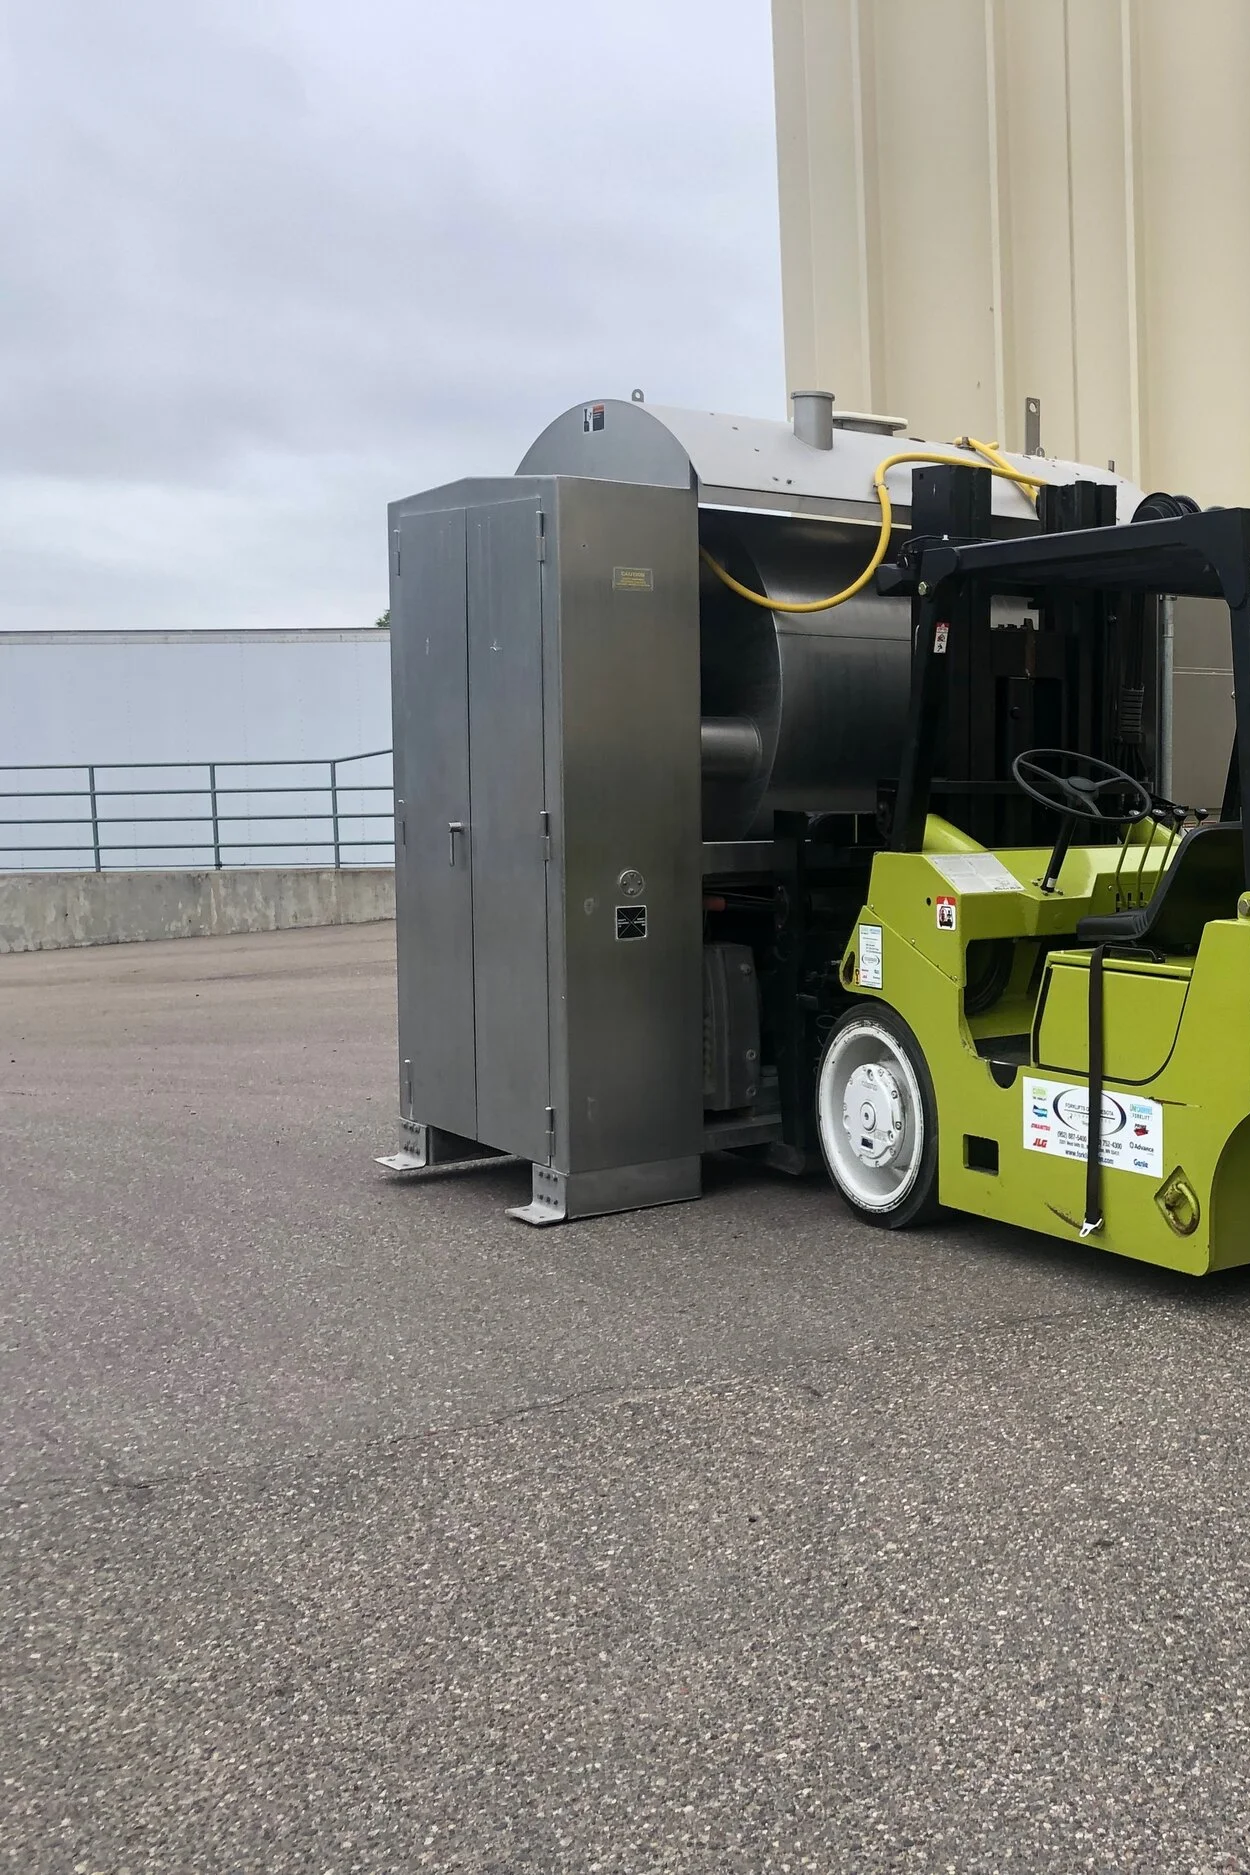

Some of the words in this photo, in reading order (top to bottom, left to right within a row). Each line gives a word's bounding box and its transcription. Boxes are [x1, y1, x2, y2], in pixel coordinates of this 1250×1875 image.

[1033, 1138, 1048, 1148] JLG
[1134, 1143, 1154, 1153] Advance
[1133, 1158, 1149, 1168] Genie
